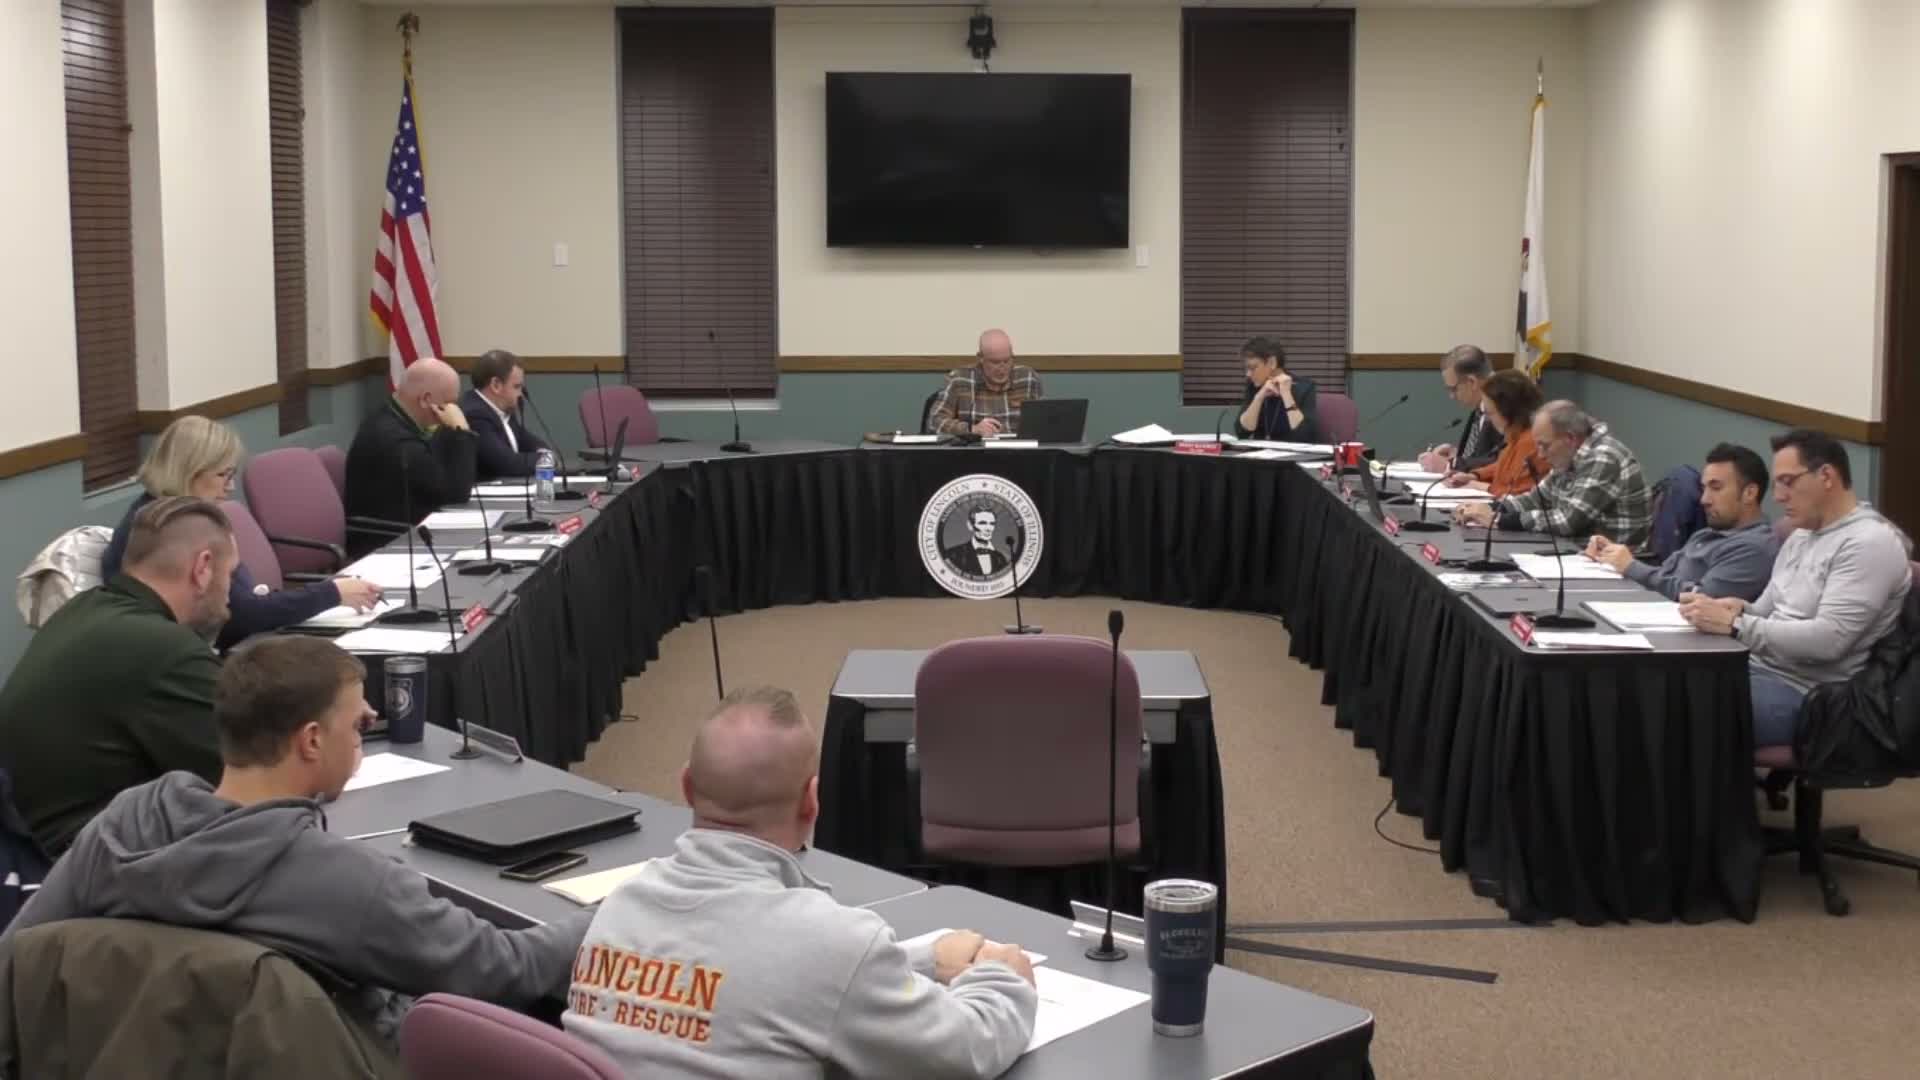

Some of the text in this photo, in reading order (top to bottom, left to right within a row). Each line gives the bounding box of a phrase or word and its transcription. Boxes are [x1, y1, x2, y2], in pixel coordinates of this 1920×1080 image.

[926, 483, 970, 561] CITY OF LINCOLN
[994, 483, 1038, 566] STATE OF ILLINOIS
[574, 944, 723, 1011] LINCOLN
[614, 1000, 711, 1042] RESCUE
